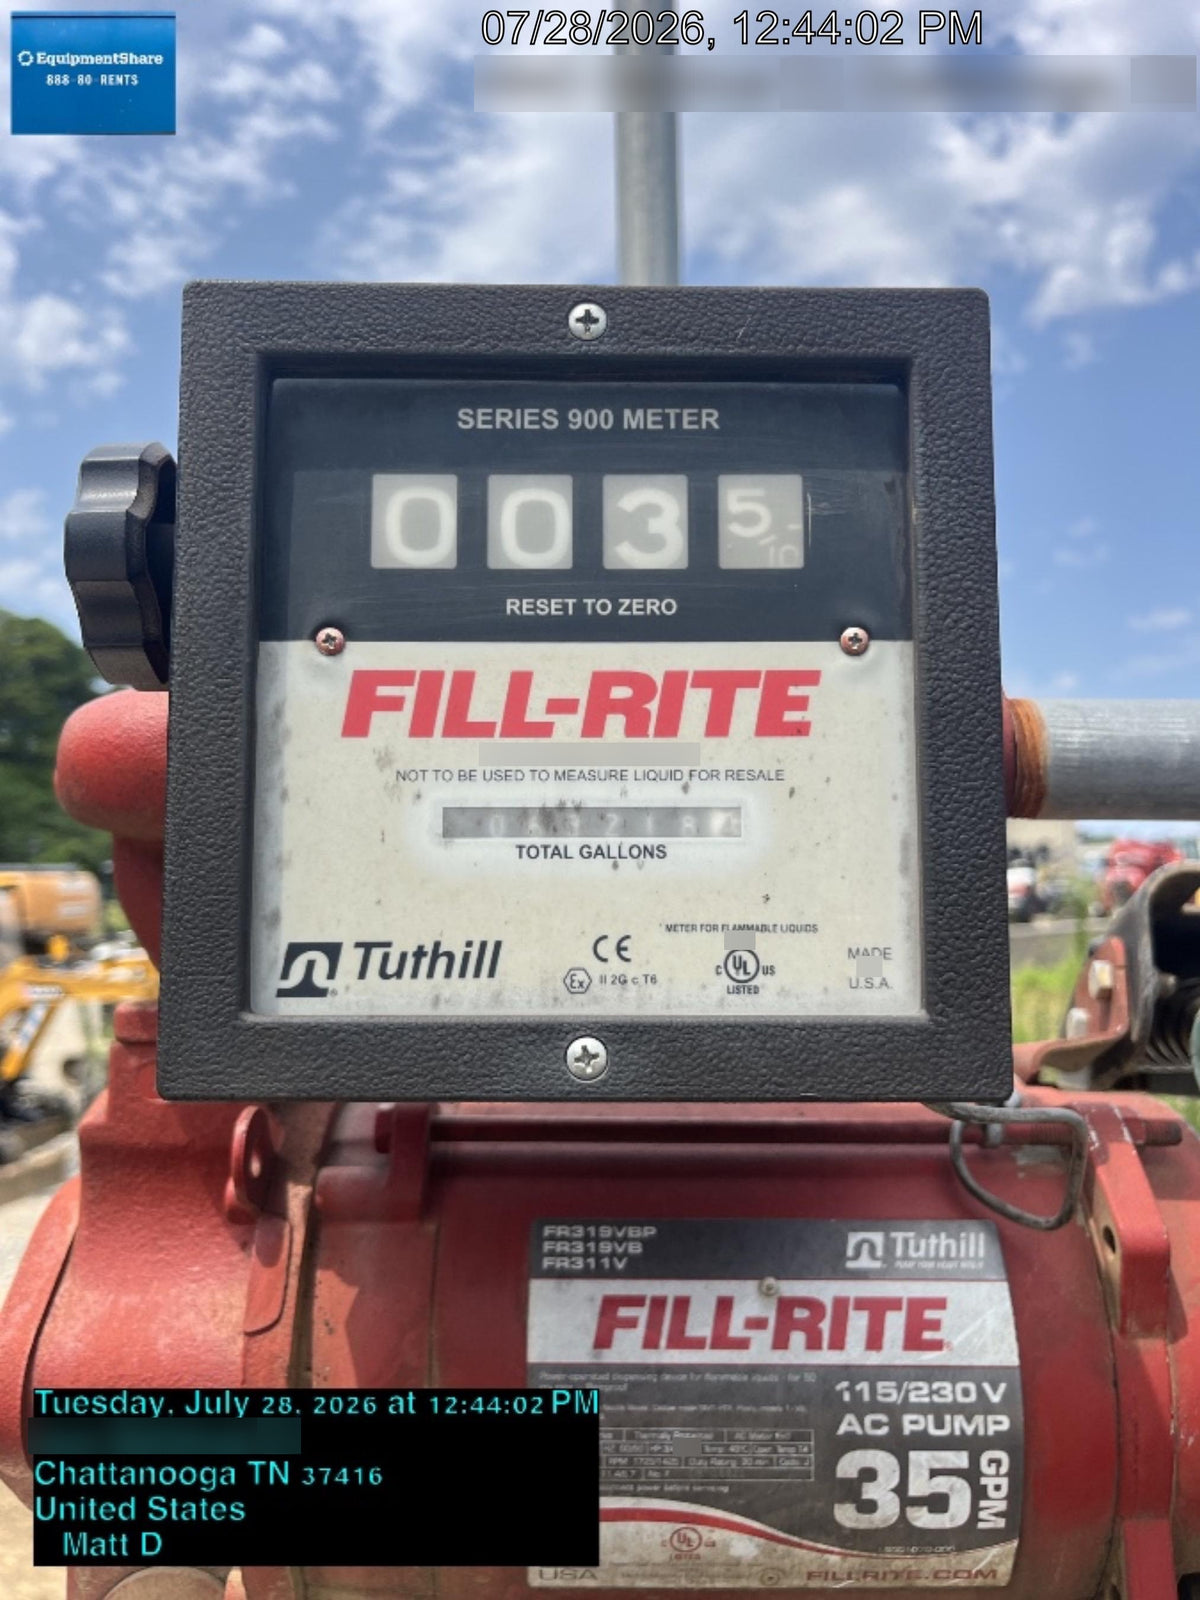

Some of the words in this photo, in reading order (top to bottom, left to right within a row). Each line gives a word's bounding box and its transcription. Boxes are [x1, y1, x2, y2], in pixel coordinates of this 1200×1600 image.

[457, 408, 559, 430] SERIES
[568, 408, 614, 430] 900
[623, 408, 720, 430] METER
[506, 598, 577, 616] RESET
[583, 598, 613, 616] TO
[618, 598, 678, 616] ZERO
[341, 669, 822, 738] FILL-RITE
[396, 769, 428, 782] NOT
[431, 769, 455, 782] TO
[458, 769, 478, 782] BE
[482, 769, 525, 782] USED
[529, 769, 551, 782] TO
[554, 769, 629, 782] MEASURE
[634, 769, 684, 783] LIQUID
[689, 769, 721, 782] FOR
[725, 769, 785, 782] RESALE
[516, 844, 573, 860] TOTAL
[579, 844, 668, 861] GALLONS
[665, 923, 698, 934] METER
[701, 923, 719, 934] FOR
[781, 923, 818, 934] LIQUIDS
[592, 934, 632, 963] CE
[847, 947, 893, 960] MADE
[354, 940, 502, 980] Tuthill
[763, 965, 775, 976] US
[643, 974, 657, 985] T6
[849, 977, 893, 990] U.S.A.
[727, 985, 760, 995] LISTED
[542, 1225, 657, 1238] FR319VBP
[542, 1240, 643, 1254] FR319VB
[890, 1231, 985, 1258] Tuthill
[542, 1256, 628, 1270] FR311V
[593, 1294, 947, 1352] FILL-RITE
[835, 1381, 978, 1404] 115/230
[982, 1382, 1007, 1404] V
[836, 1413, 890, 1436] AC
[902, 1414, 1010, 1437] PUMP
[833, 1449, 971, 1530] 35
[977, 1449, 1010, 1530] GPM
[538, 1568, 598, 1581] USA
